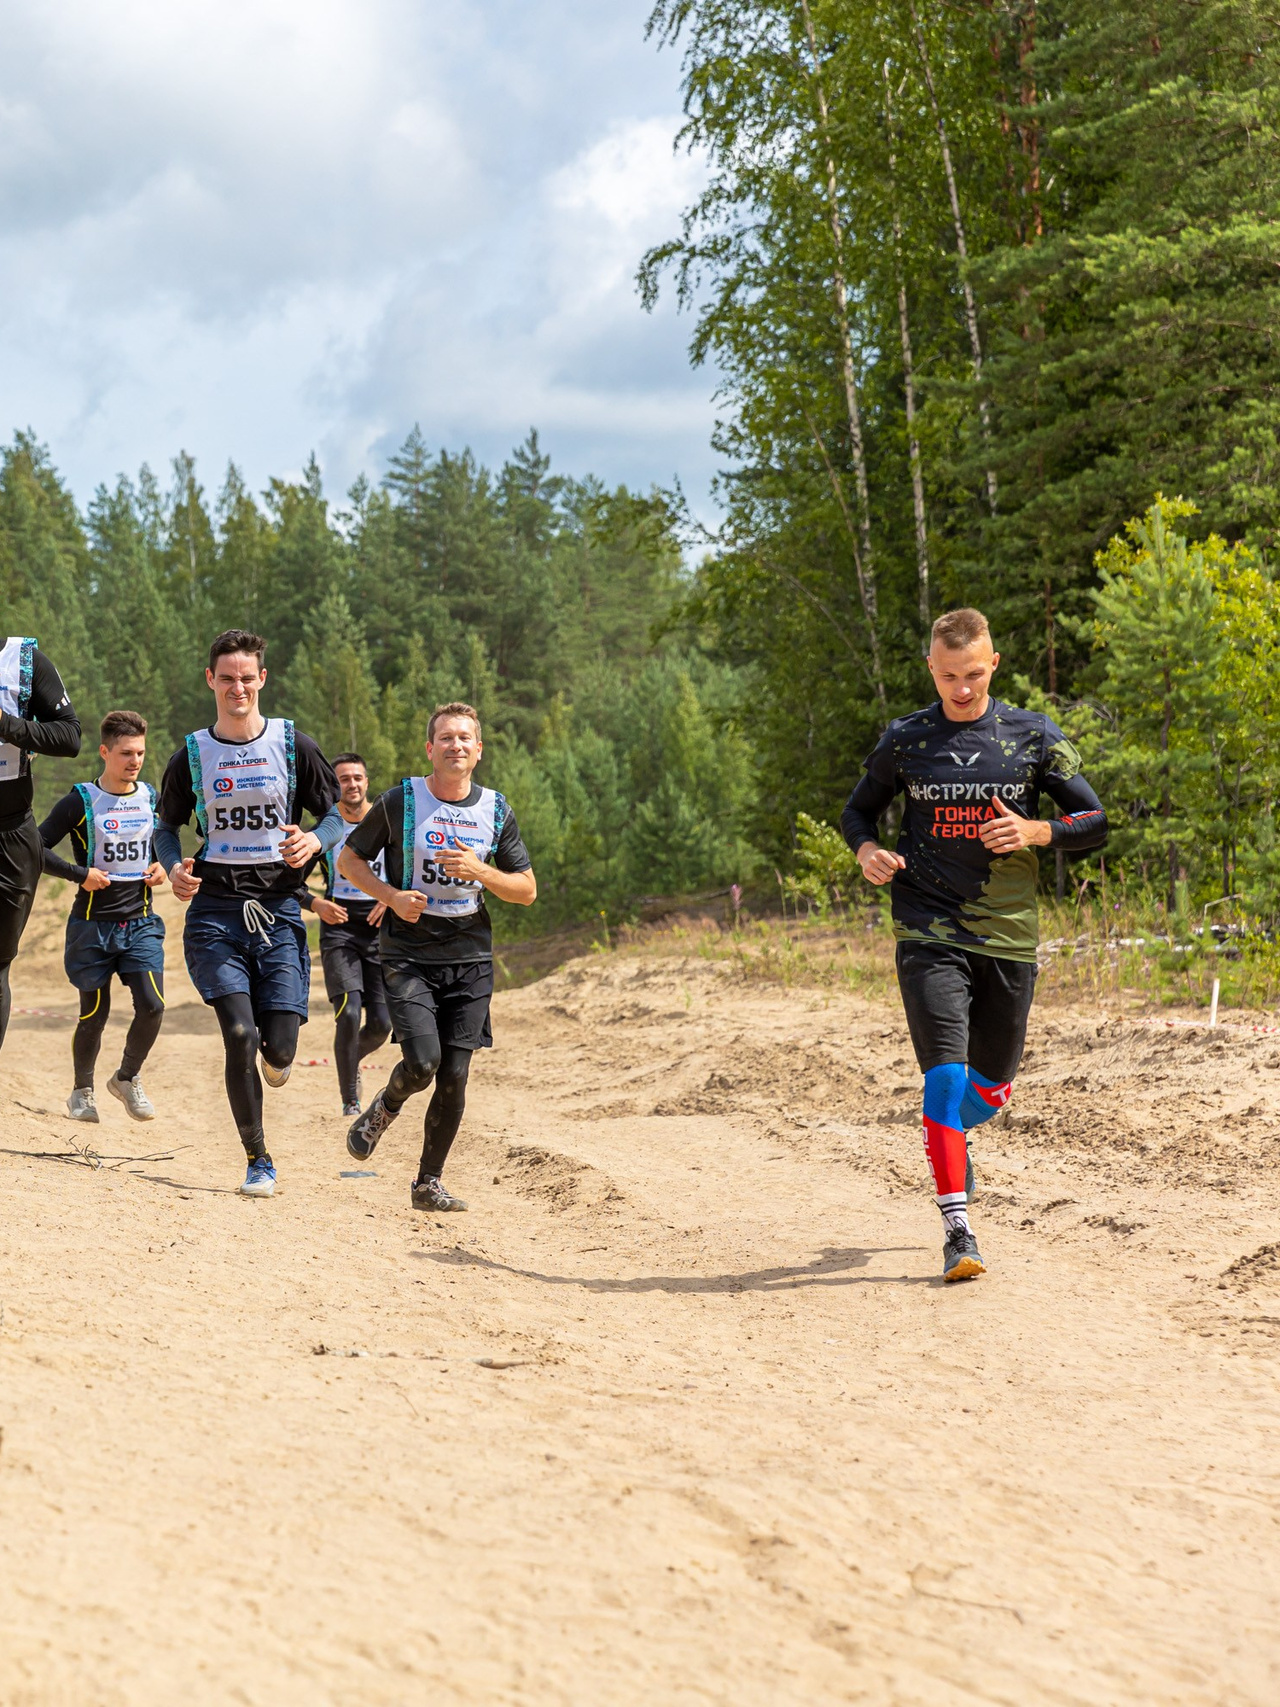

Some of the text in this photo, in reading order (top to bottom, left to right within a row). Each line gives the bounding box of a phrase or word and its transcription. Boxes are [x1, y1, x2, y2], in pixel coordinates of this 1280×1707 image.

[236, 775, 277, 783] ИНЖЕНЕРНЫЕ
[237, 781, 266, 789] СИСТЕМЫ
[908, 783, 1025, 800] ИНСТРУКТОР
[215, 804, 279, 831] 5955
[434, 816, 477, 827] ГОНКА ГЕРОЕВ
[935, 806, 996, 822] ГОНКА
[932, 822, 982, 839] ГЕРО
[103, 840, 147, 863] 5951
